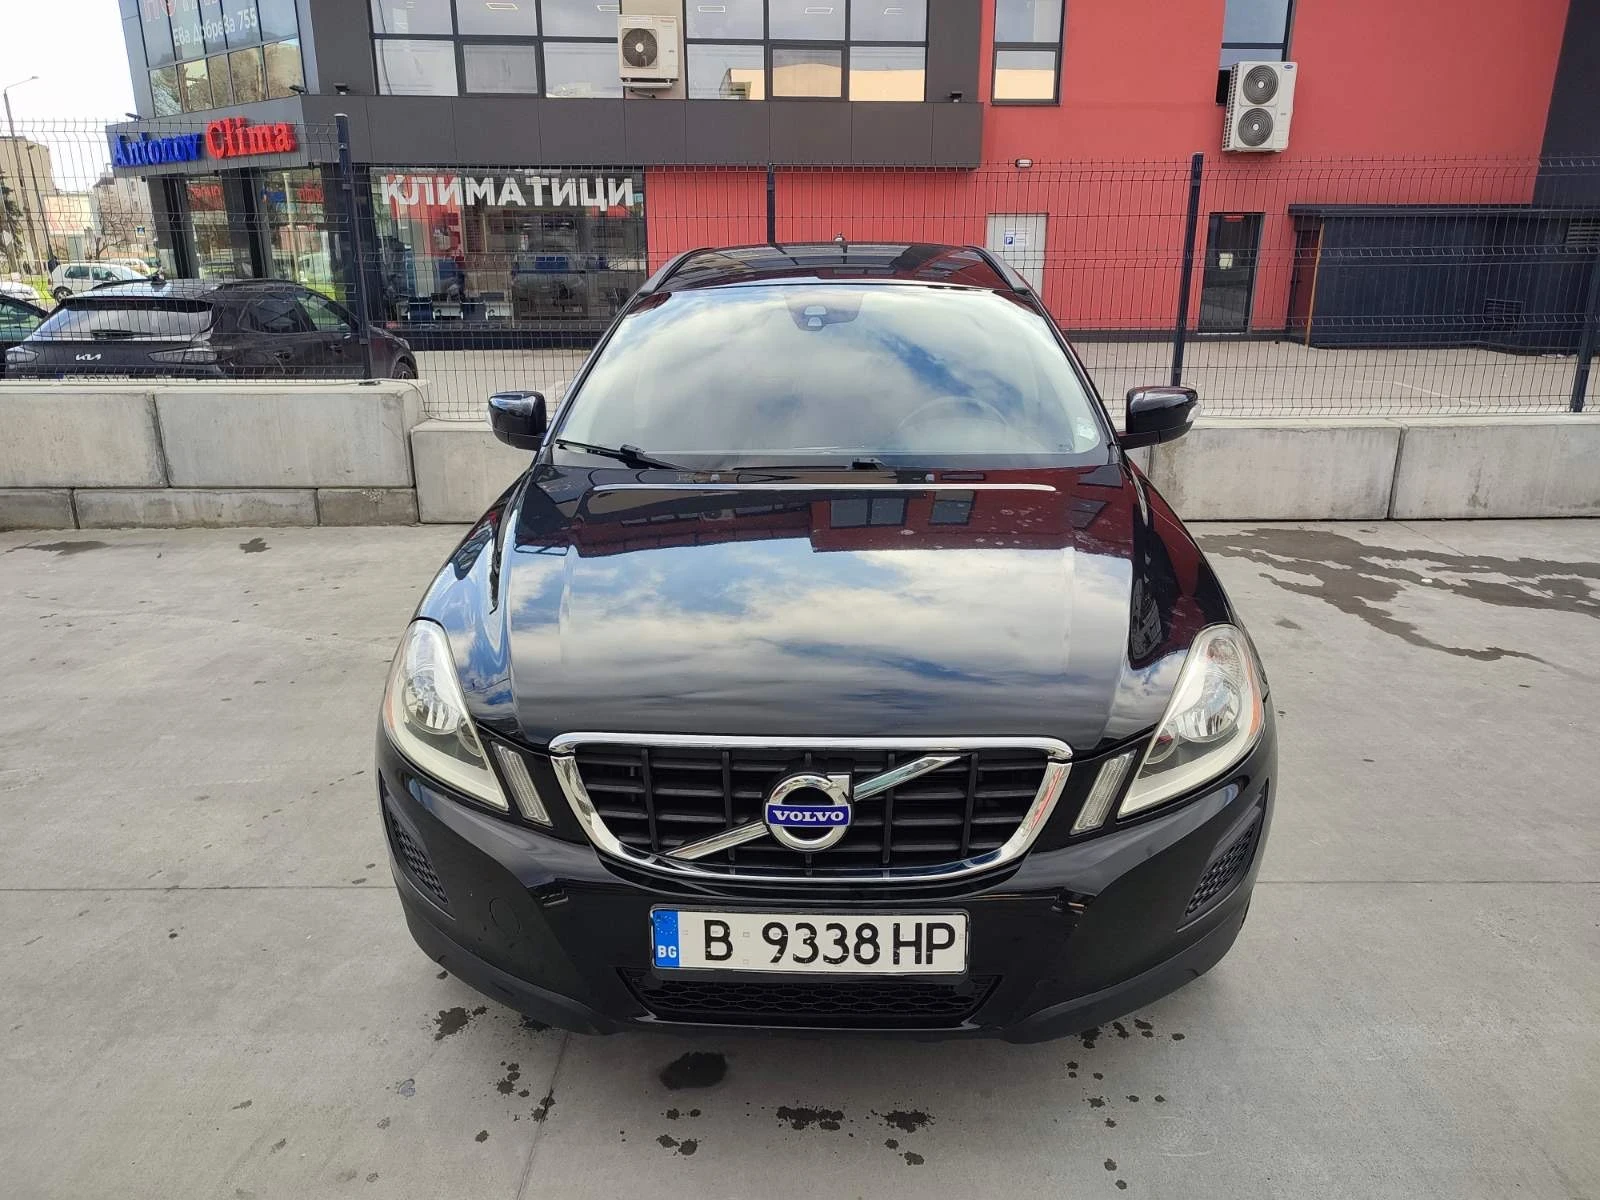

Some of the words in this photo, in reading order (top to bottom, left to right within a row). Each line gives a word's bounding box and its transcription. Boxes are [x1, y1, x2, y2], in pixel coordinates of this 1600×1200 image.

[206, 117, 297, 160] Clima
[380, 175, 633, 212] КЛИМАТИЦИ
[772, 809, 845, 822] VOLVO
[657, 945, 677, 959] BG
